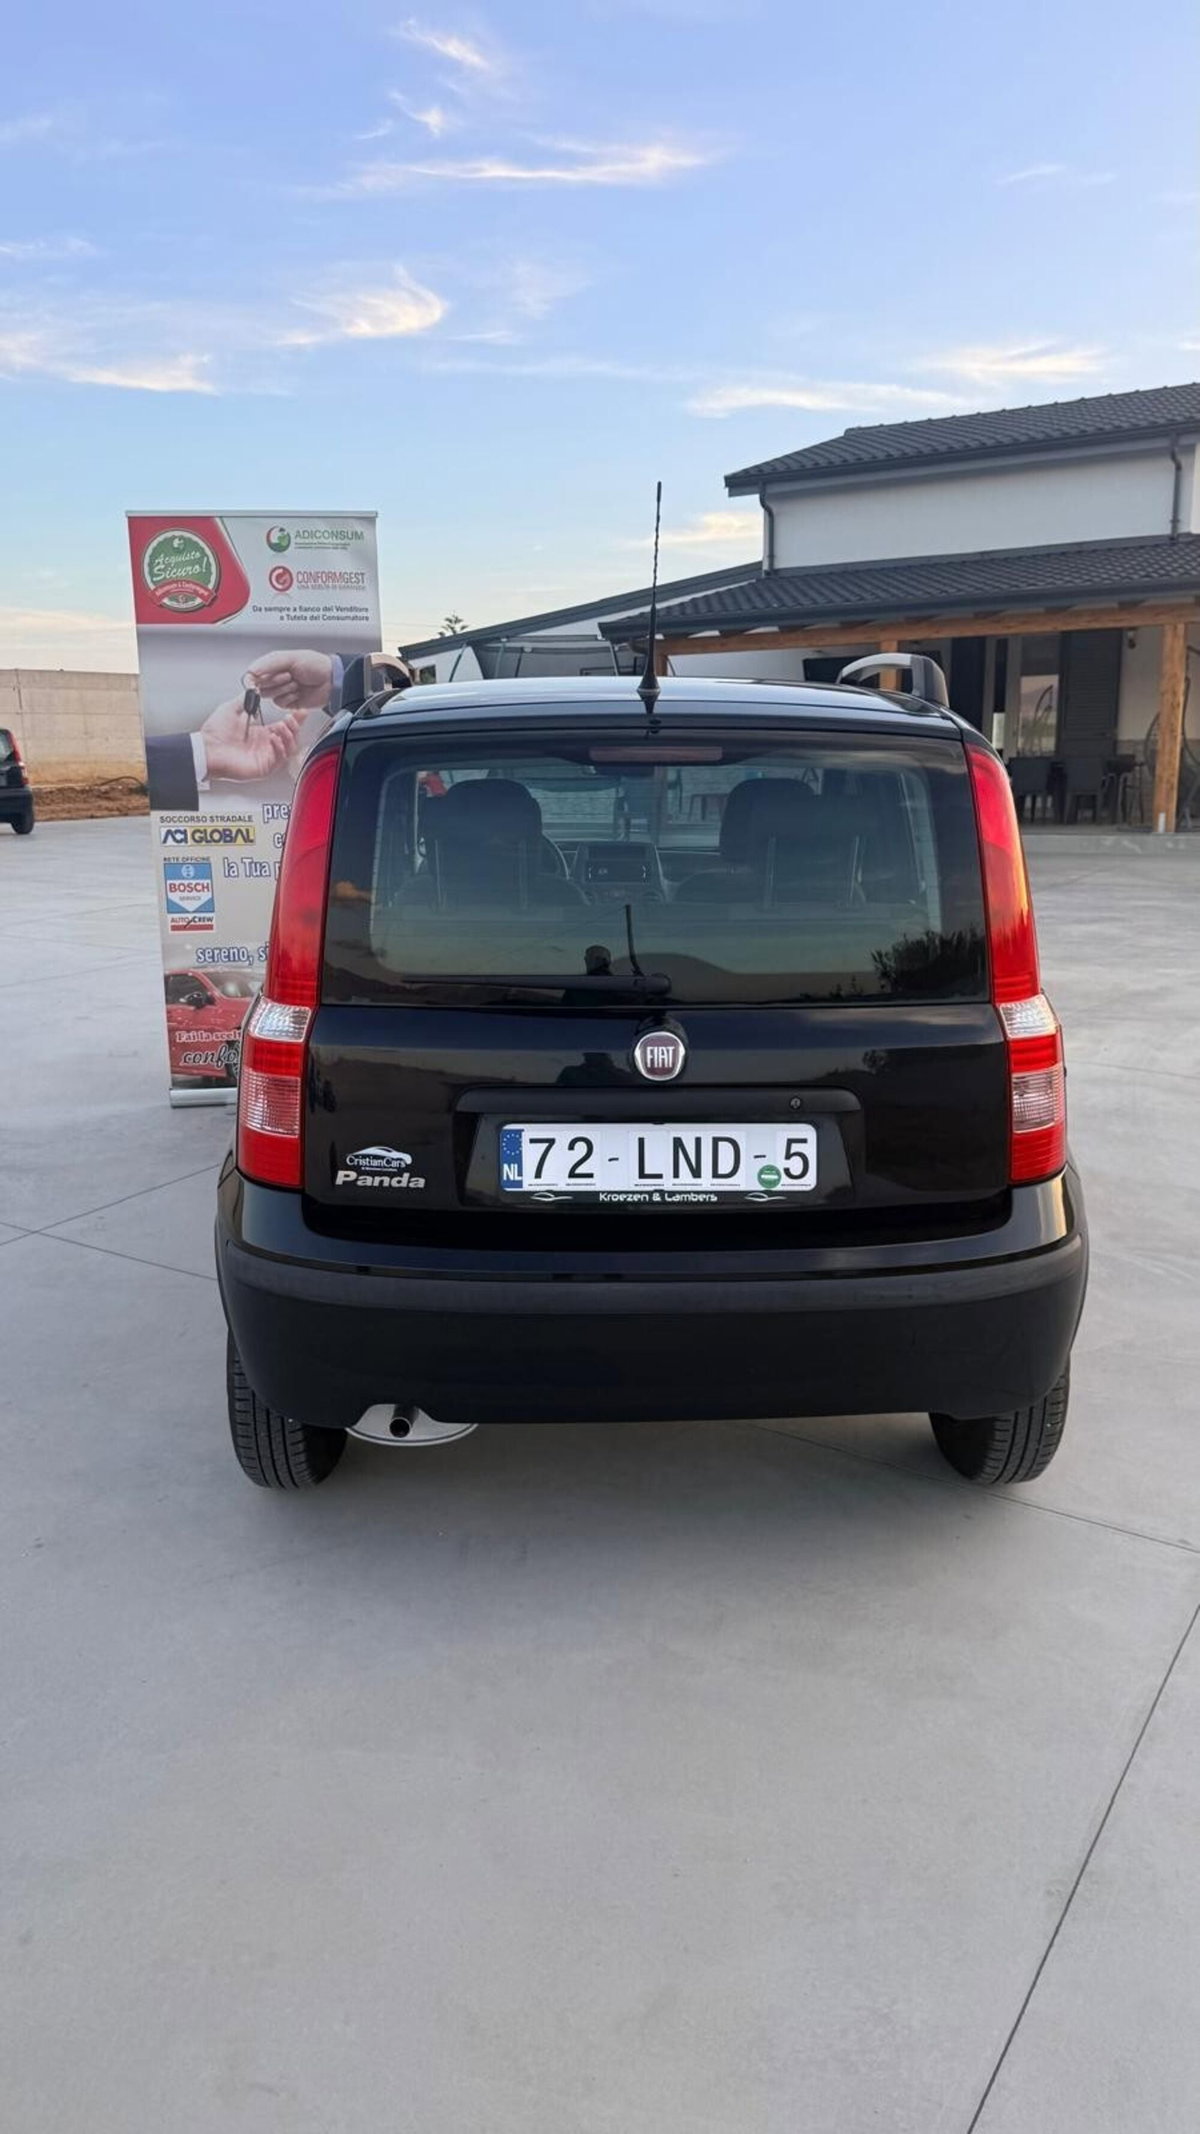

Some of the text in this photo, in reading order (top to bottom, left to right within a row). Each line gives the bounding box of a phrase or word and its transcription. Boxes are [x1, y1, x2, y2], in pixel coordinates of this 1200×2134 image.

[294, 529, 365, 541] ADICONSUM
[153, 550, 201, 567] Acquisto
[152, 556, 208, 581] Sicuro!
[296, 570, 366, 585] CONFORMGEST
[252, 604, 262, 613] Da
[264, 606, 291, 615] sempre
[298, 604, 321, 613] fianco
[322, 604, 333, 613] del
[335, 604, 369, 613] Venditore
[286, 613, 308, 622] Tutela
[309, 613, 320, 622] del
[321, 614, 370, 623] Consumatore
[160, 814, 254, 824] SOCCORSO STRADALE
[262, 803, 292, 824] pre
[162, 827, 254, 844] ACI GLOBAL
[223, 856, 239, 878] la
[241, 857, 271, 878] Tua
[169, 882, 210, 893] BOSCH
[196, 945, 254, 967] sereno,
[175, 1030, 196, 1043] Fai
[198, 1030, 212, 1042] la
[646, 1046, 675, 1069] FIAT
[345, 1155, 406, 1168] CristianCars
[335, 1170, 426, 1188] Panda
[503, 1163, 523, 1181] NL
[599, 1191, 718, 1202] Kroezen & Lambers
